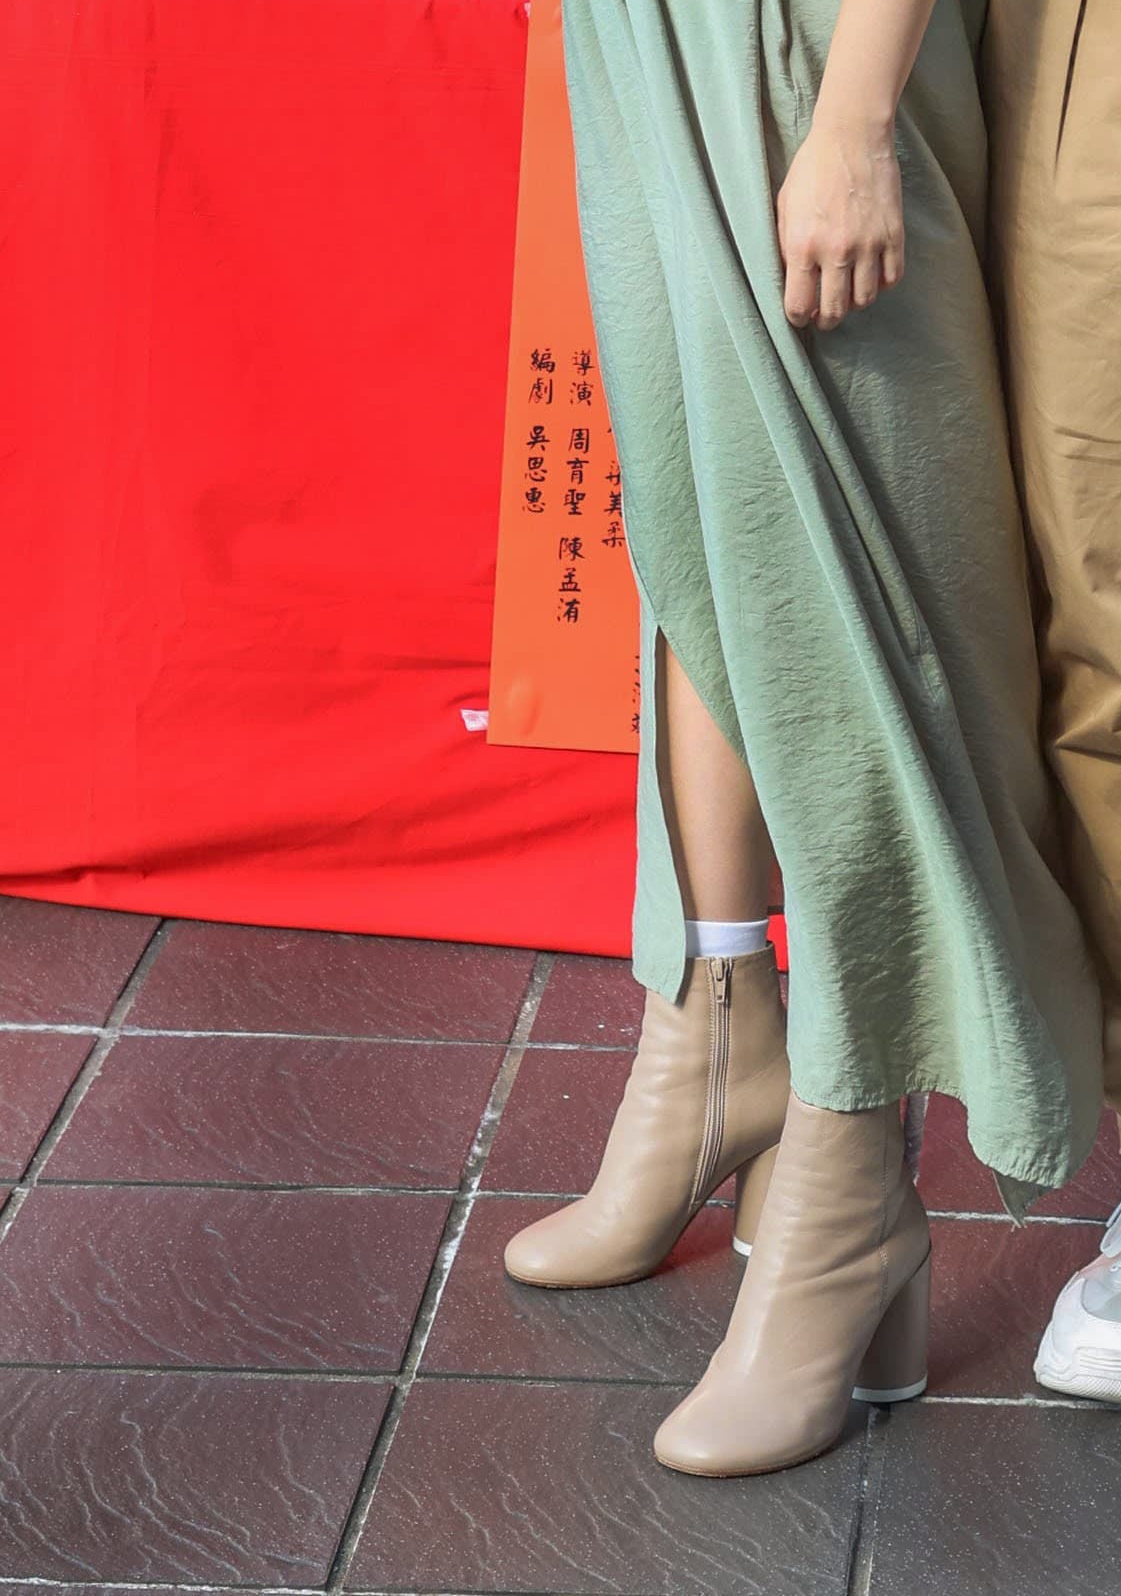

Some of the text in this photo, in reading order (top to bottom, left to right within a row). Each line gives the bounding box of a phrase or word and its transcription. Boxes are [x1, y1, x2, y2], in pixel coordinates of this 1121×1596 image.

[528, 348, 556, 405] 編劇
[569, 348, 595, 407] 導演
[563, 427, 590, 516] 周育聖
